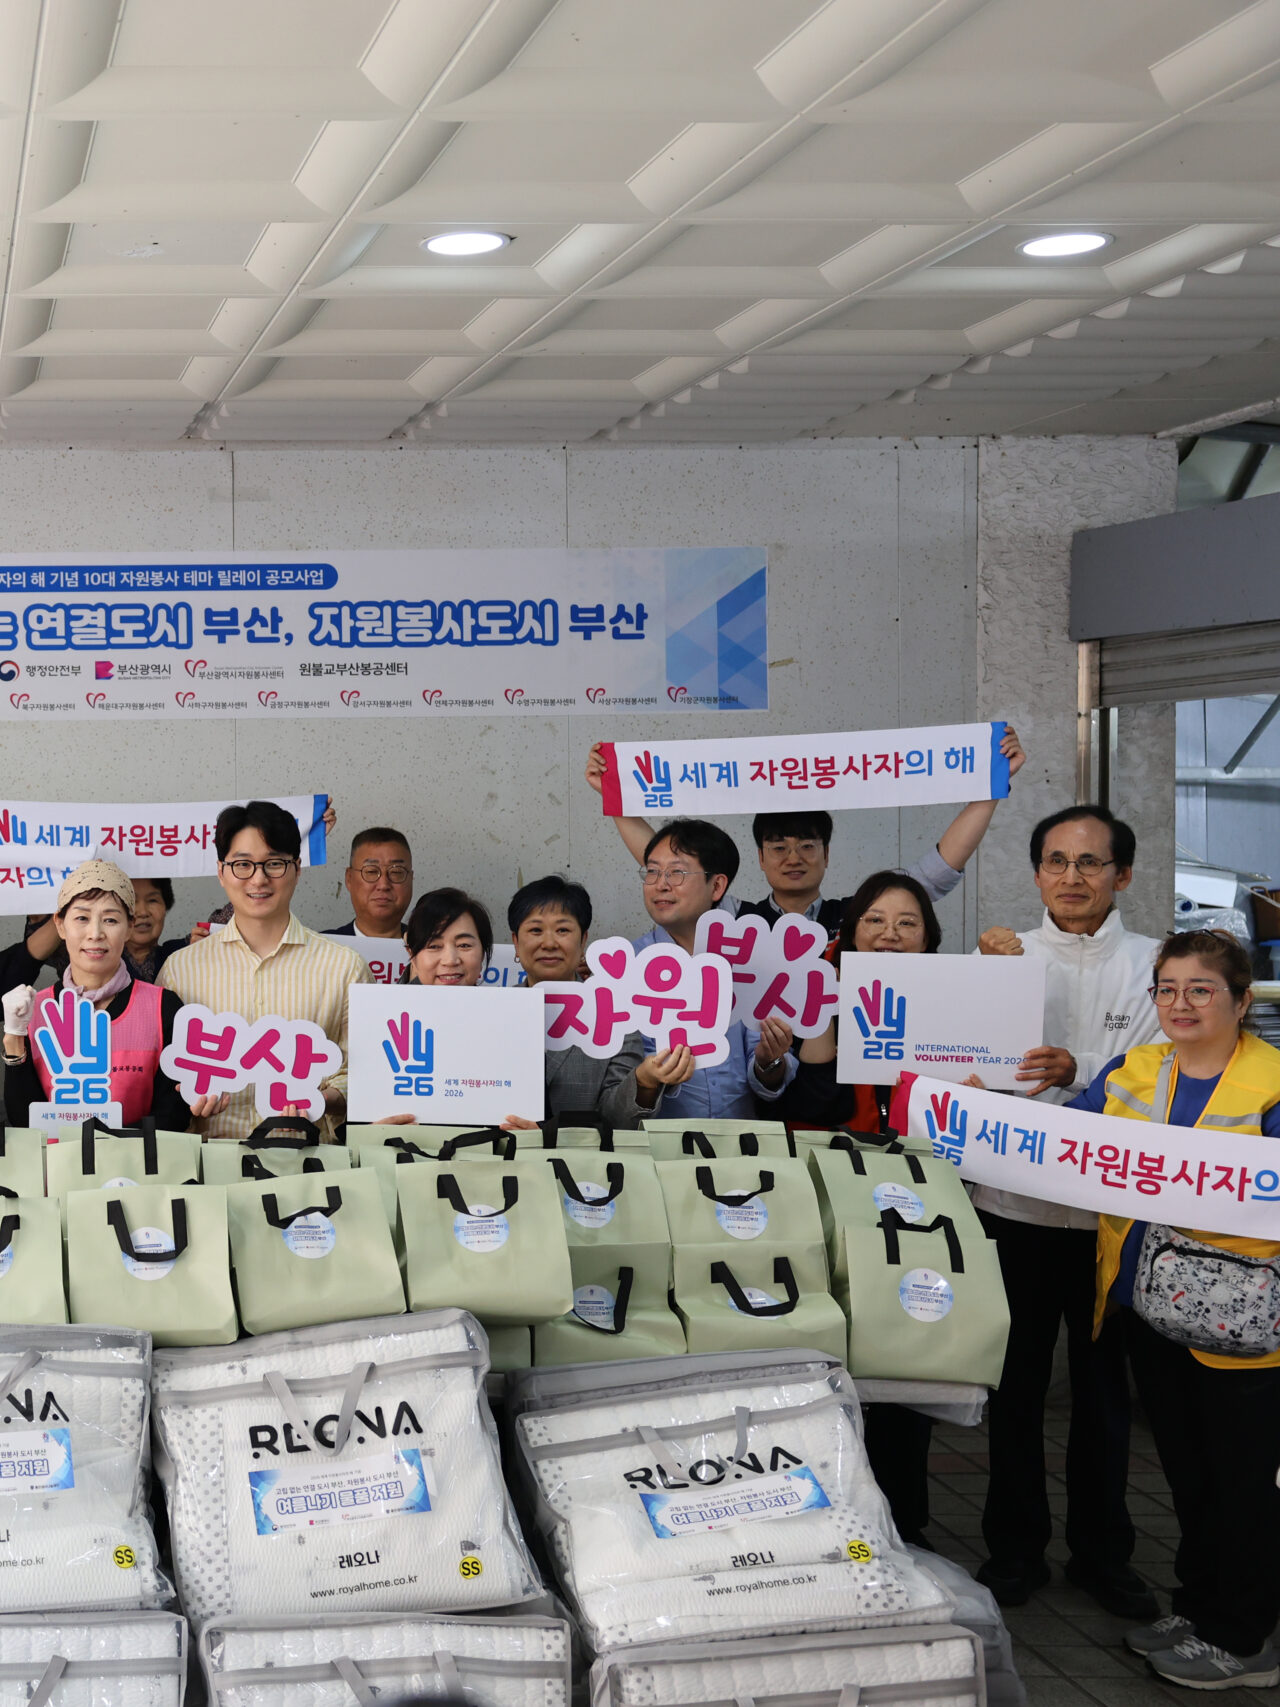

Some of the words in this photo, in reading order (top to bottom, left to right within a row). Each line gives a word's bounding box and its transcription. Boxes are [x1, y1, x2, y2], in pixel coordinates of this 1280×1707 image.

[30, 571, 45, 588] 해
[50, 571, 79, 588] 기념
[83, 571, 116, 587] 10대
[120, 570, 179, 587] 자원봉사
[183, 570, 213, 586] 테마
[217, 569, 260, 586] 릴레이
[265, 569, 324, 586] 공모사업
[23, 601, 193, 651] 연결도시
[202, 606, 294, 646] 부산,
[308, 599, 559, 648] 자원봉사도시
[569, 602, 648, 641] 부산
[25, 664, 82, 677] 행정안전부
[116, 663, 172, 676] 부산광역시
[298, 662, 408, 676] 원불교부산봉공센터
[679, 760, 740, 790] 세계
[749, 749, 933, 790] 자원봉사자의
[944, 744, 975, 775] 해
[644, 793, 674, 808] 26
[34, 824, 91, 848] 세계
[100, 824, 218, 857] 자원봉사
[863, 1040, 904, 1060] 26
[914, 1044, 991, 1054] INTERNATIONAL
[174, 1018, 328, 1112] 부산
[914, 1054, 974, 1064] VOLUNTEER
[976, 1056, 1002, 1064] YEAR
[55, 1078, 108, 1104] 26
[394, 1076, 434, 1096] 26
[444, 1078, 459, 1086] 세계
[460, 1079, 502, 1088] 자원봉사자의
[504, 1080, 512, 1088] 해
[444, 1088, 464, 1097] 2026
[975, 1118, 1047, 1166] 세계
[18, 1458, 50, 1476] 지원
[115, 1548, 133, 1564] SS
[338, 1550, 381, 1570] 레오나
[730, 1550, 775, 1568] 레오나
[848, 1542, 870, 1561] SS
[460, 1560, 482, 1576] SS
[310, 1574, 418, 1600] www.royalhome.co.kr
[707, 1573, 817, 1598] www.royalhome.co.kr
